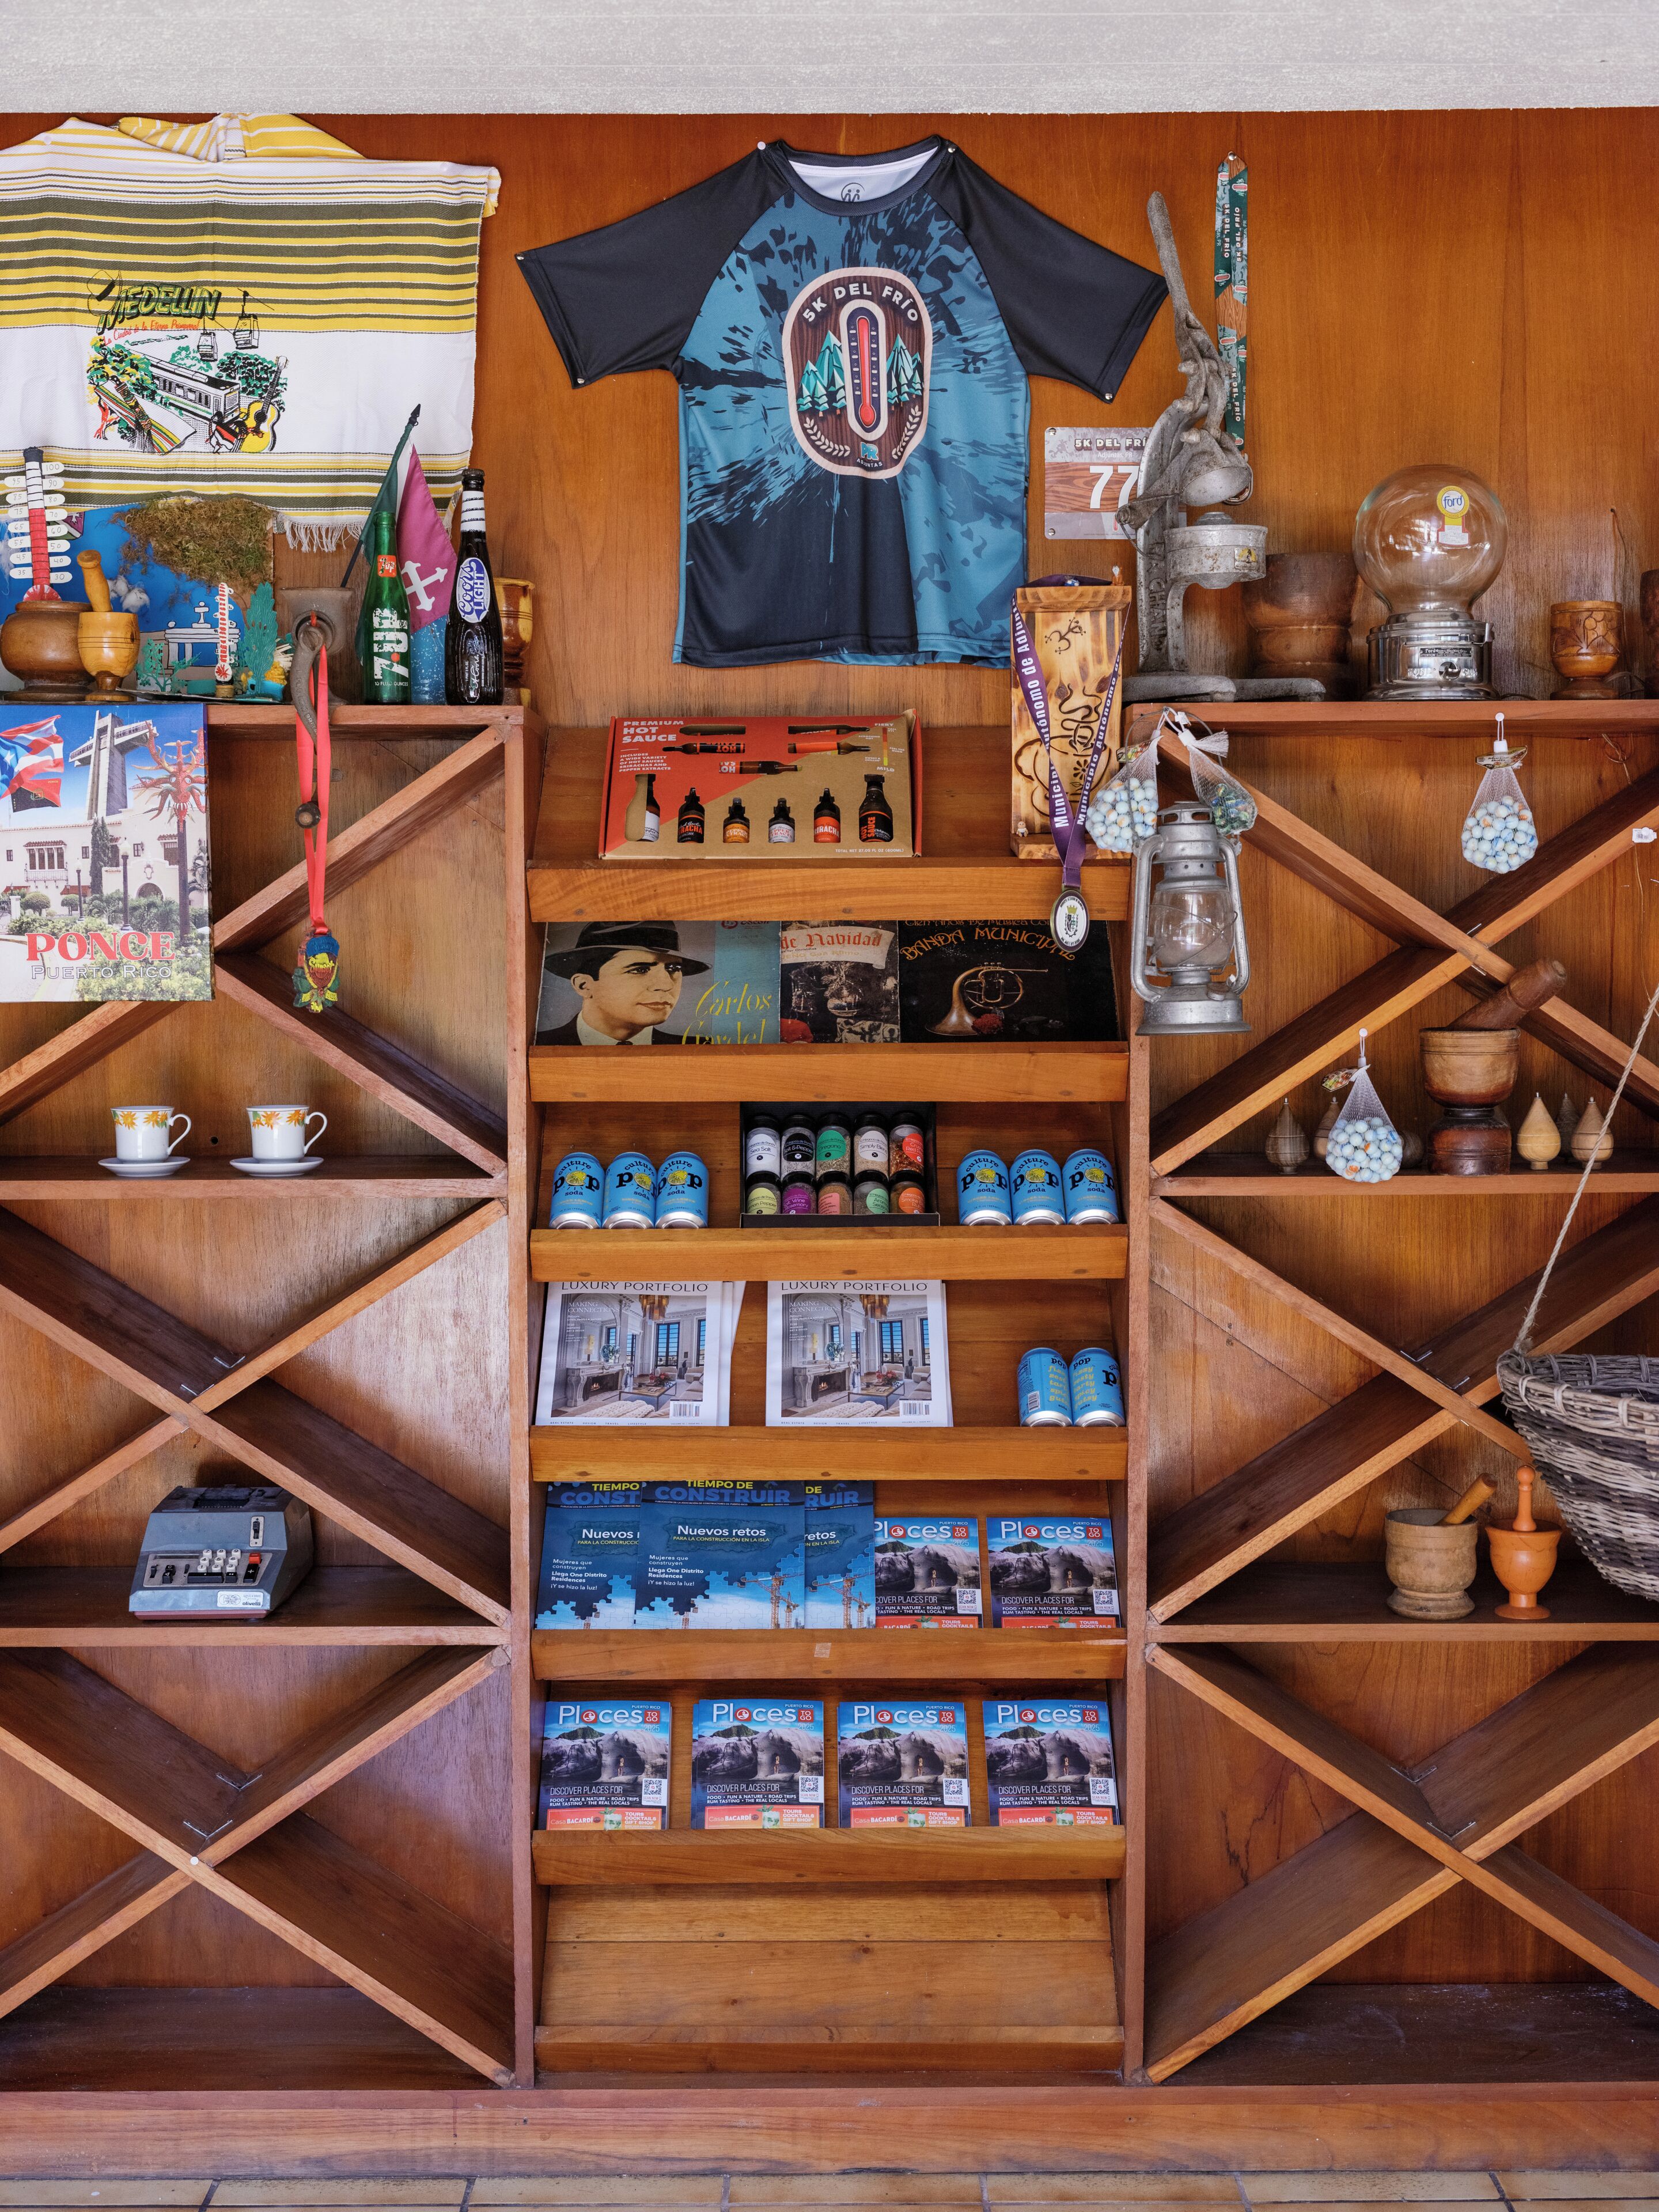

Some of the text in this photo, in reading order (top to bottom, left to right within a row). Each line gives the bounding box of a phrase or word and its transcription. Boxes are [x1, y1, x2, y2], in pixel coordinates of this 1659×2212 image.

[97, 282, 222, 335] MEDELLIN
[802, 282, 918, 322] 5K DEL FRÍO
[114, 326, 132, 340] Ciudad
[142, 321, 148, 330] la
[150, 320, 169, 330] Eterna
[1234, 402, 1242, 422] FRÍO
[1075, 436, 1147, 450] 5K DEL FRÍ
[860, 442, 879, 461] PR
[46, 464, 60, 472] 100
[857, 457, 883, 468] ADJUNTAS
[13, 478, 21, 486] 95
[48, 479, 57, 488] 90
[1089, 465, 1140, 509] 77
[1443, 495, 1463, 509] ford
[51, 527, 62, 535] 60
[14, 539, 24, 547] 55
[50, 542, 61, 550] 50
[16, 553, 26, 562] 45
[458, 564, 474, 618] Coors
[473, 570, 485, 611] LIGHT
[1021, 657, 1036, 676] de
[623, 726, 659, 734] HOT
[622, 734, 677, 744] SAUCE
[1077, 676, 1116, 825] Municipio Autónomo
[867, 816, 876, 837] SAUCE
[25, 931, 176, 961] PONCE
[806, 932, 884, 948] Navidad
[900, 929, 965, 961] BANDA
[695, 980, 772, 1018] Carlos
[558, 1160, 592, 1176] culture
[624, 1160, 655, 1176] culture
[965, 1157, 999, 1173] culture
[1016, 1157, 1049, 1174] culture
[1074, 1156, 1107, 1171] culture
[634, 1190, 651, 1202] soda
[666, 1189, 685, 1197] soda
[562, 1281, 706, 1292] LUXURY PORTFOLIO
[782, 1281, 927, 1291] LUXURY PORTFOLIO
[1073, 1356, 1091, 1370] pop
[592, 1482, 639, 1491] TIEMPO
[686, 1479, 753, 1490] TIEMPO DE
[654, 1487, 791, 1503] CONSTRUIR
[582, 1528, 634, 1539] Nuevos
[677, 1525, 766, 1536] Nuevos retos
[1002, 1596, 1075, 1604] DISCOVER PLACES FOR
[550, 1786, 623, 1796] DISCOVER PLACES FOR
[566, 1816, 594, 1824] BACARDÍ
[724, 1813, 752, 1821] BACARDÍ
